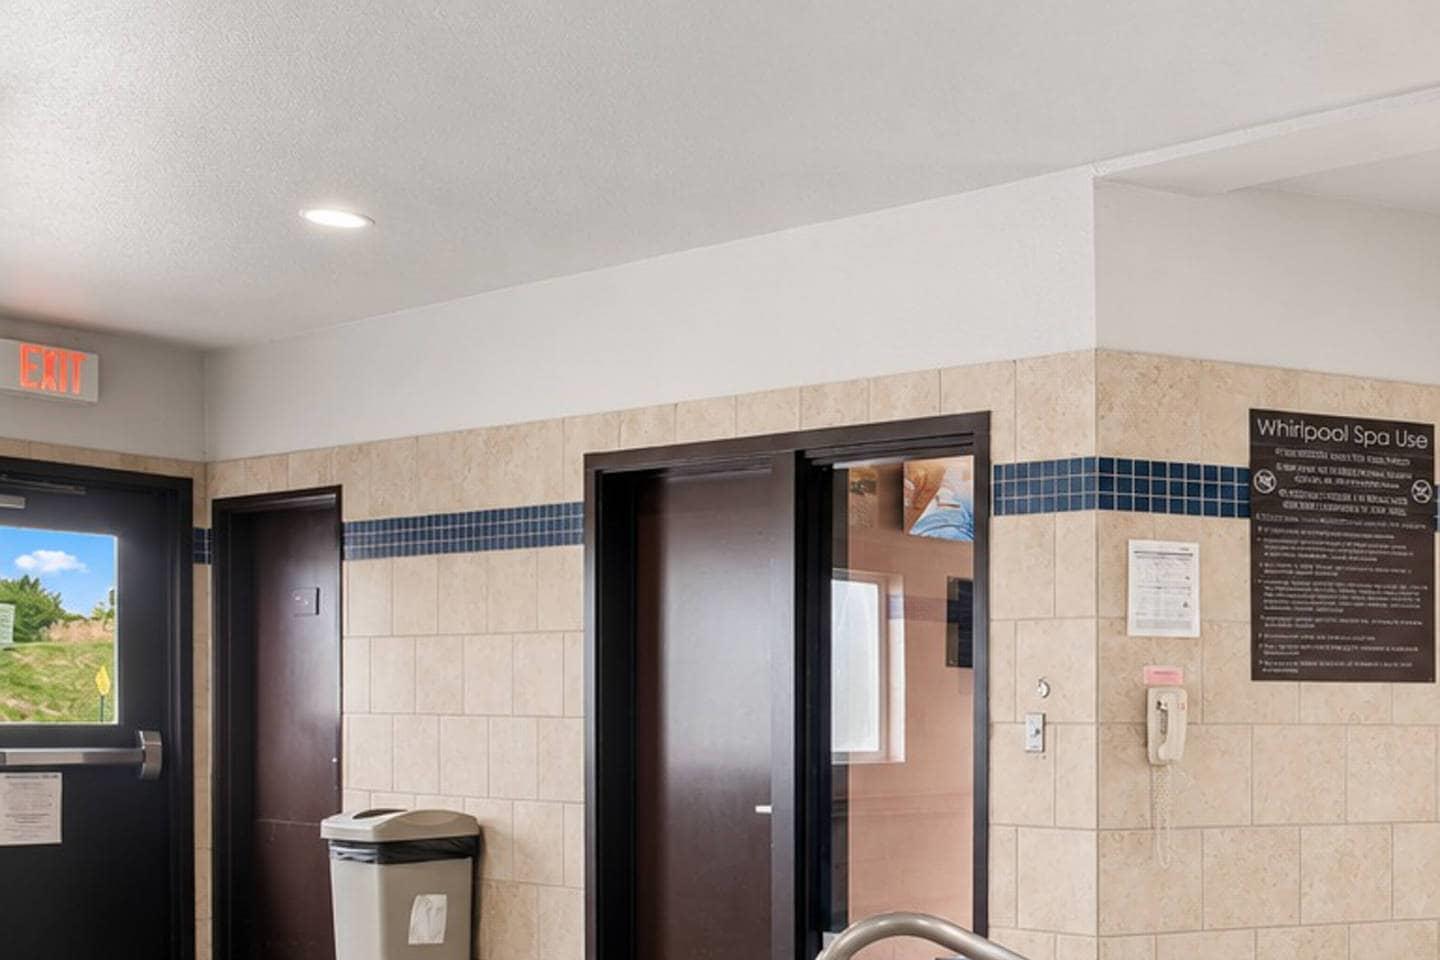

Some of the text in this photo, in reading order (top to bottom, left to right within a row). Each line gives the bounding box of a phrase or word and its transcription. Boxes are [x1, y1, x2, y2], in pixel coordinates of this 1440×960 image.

[19, 342, 87, 395] EXIT
[1256, 417, 1429, 449] Whirlpool Spa Use
